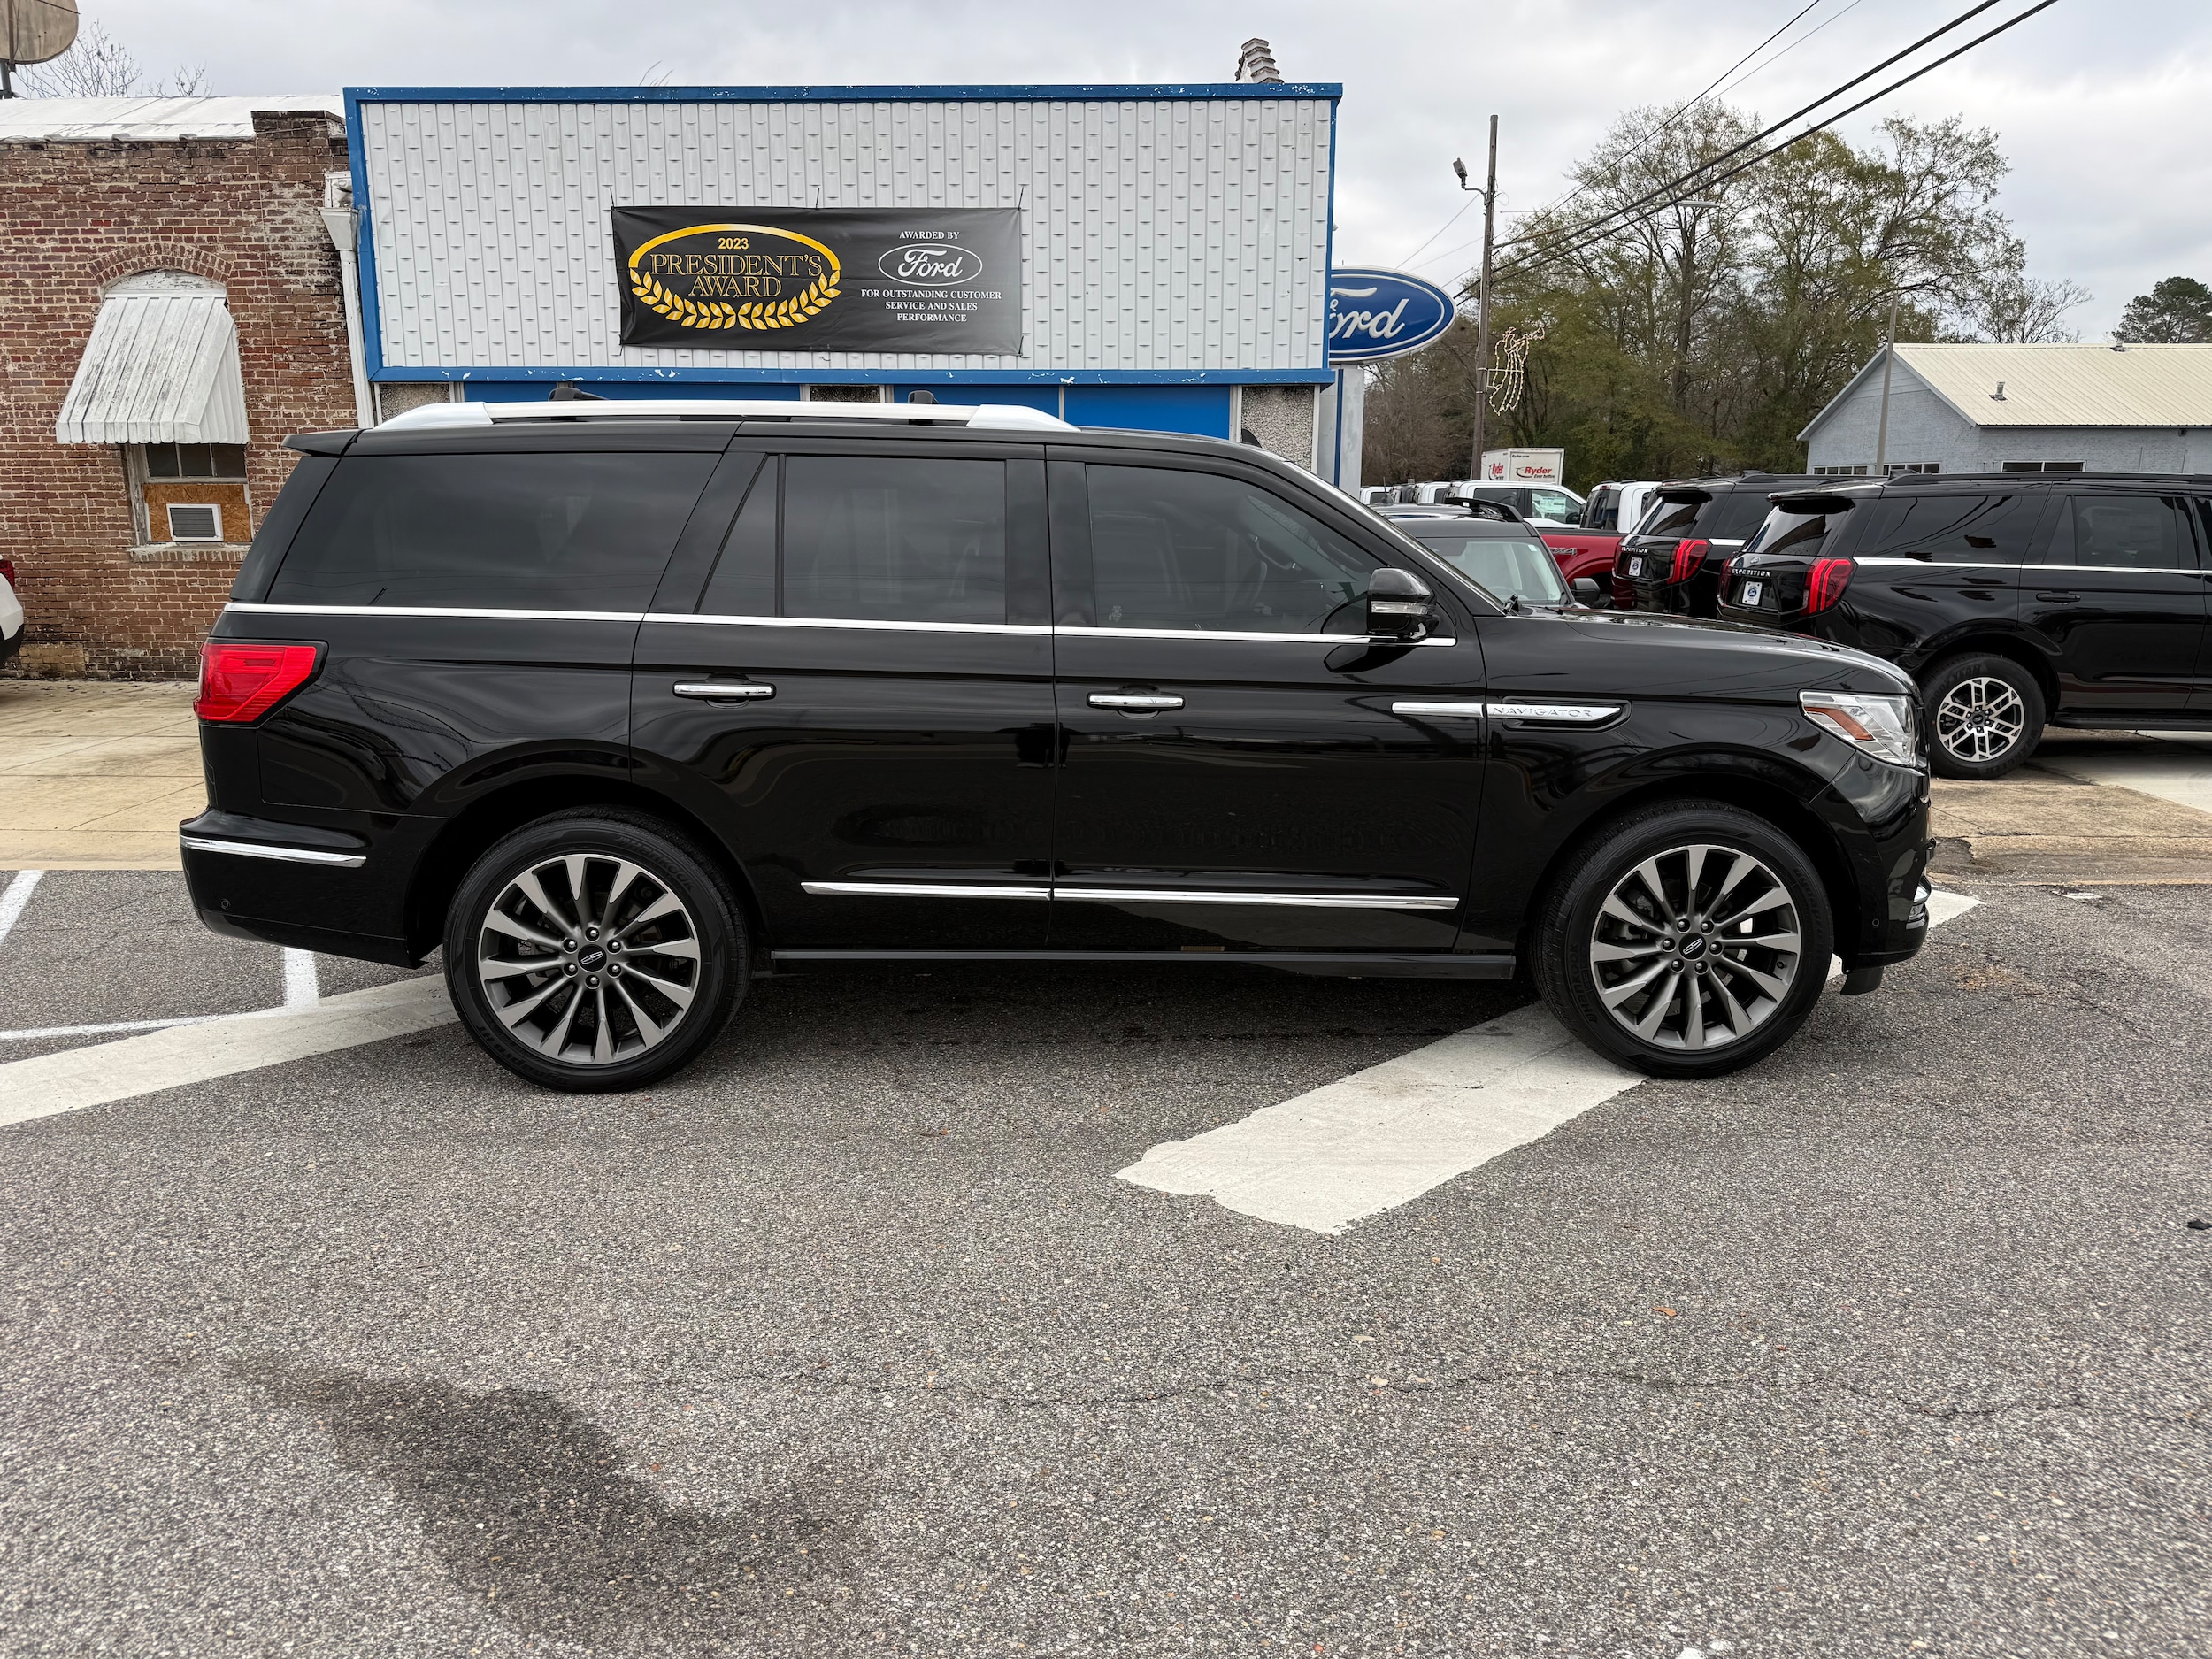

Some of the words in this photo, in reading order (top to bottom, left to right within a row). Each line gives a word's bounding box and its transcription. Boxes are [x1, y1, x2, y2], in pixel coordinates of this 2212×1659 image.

[899, 231, 945, 240] AWARDED
[947, 231, 960, 240] BY
[718, 237, 749, 250] 2023
[650, 254, 823, 276] PRESIDENT'S
[897, 249, 964, 278] Ford
[688, 276, 782, 297] AWARD
[882, 289, 949, 299] OUTSTANDING
[950, 291, 1002, 300] CUSTOMER
[927, 302, 948, 311] AND
[897, 313, 967, 322] PERFORMANCE
[1329, 288, 1410, 339] ord
[1525, 466, 1553, 475] Ryder
[1732, 568, 1771, 577] EXPEDITION
[1493, 707, 1594, 718] NAVIGATOR
